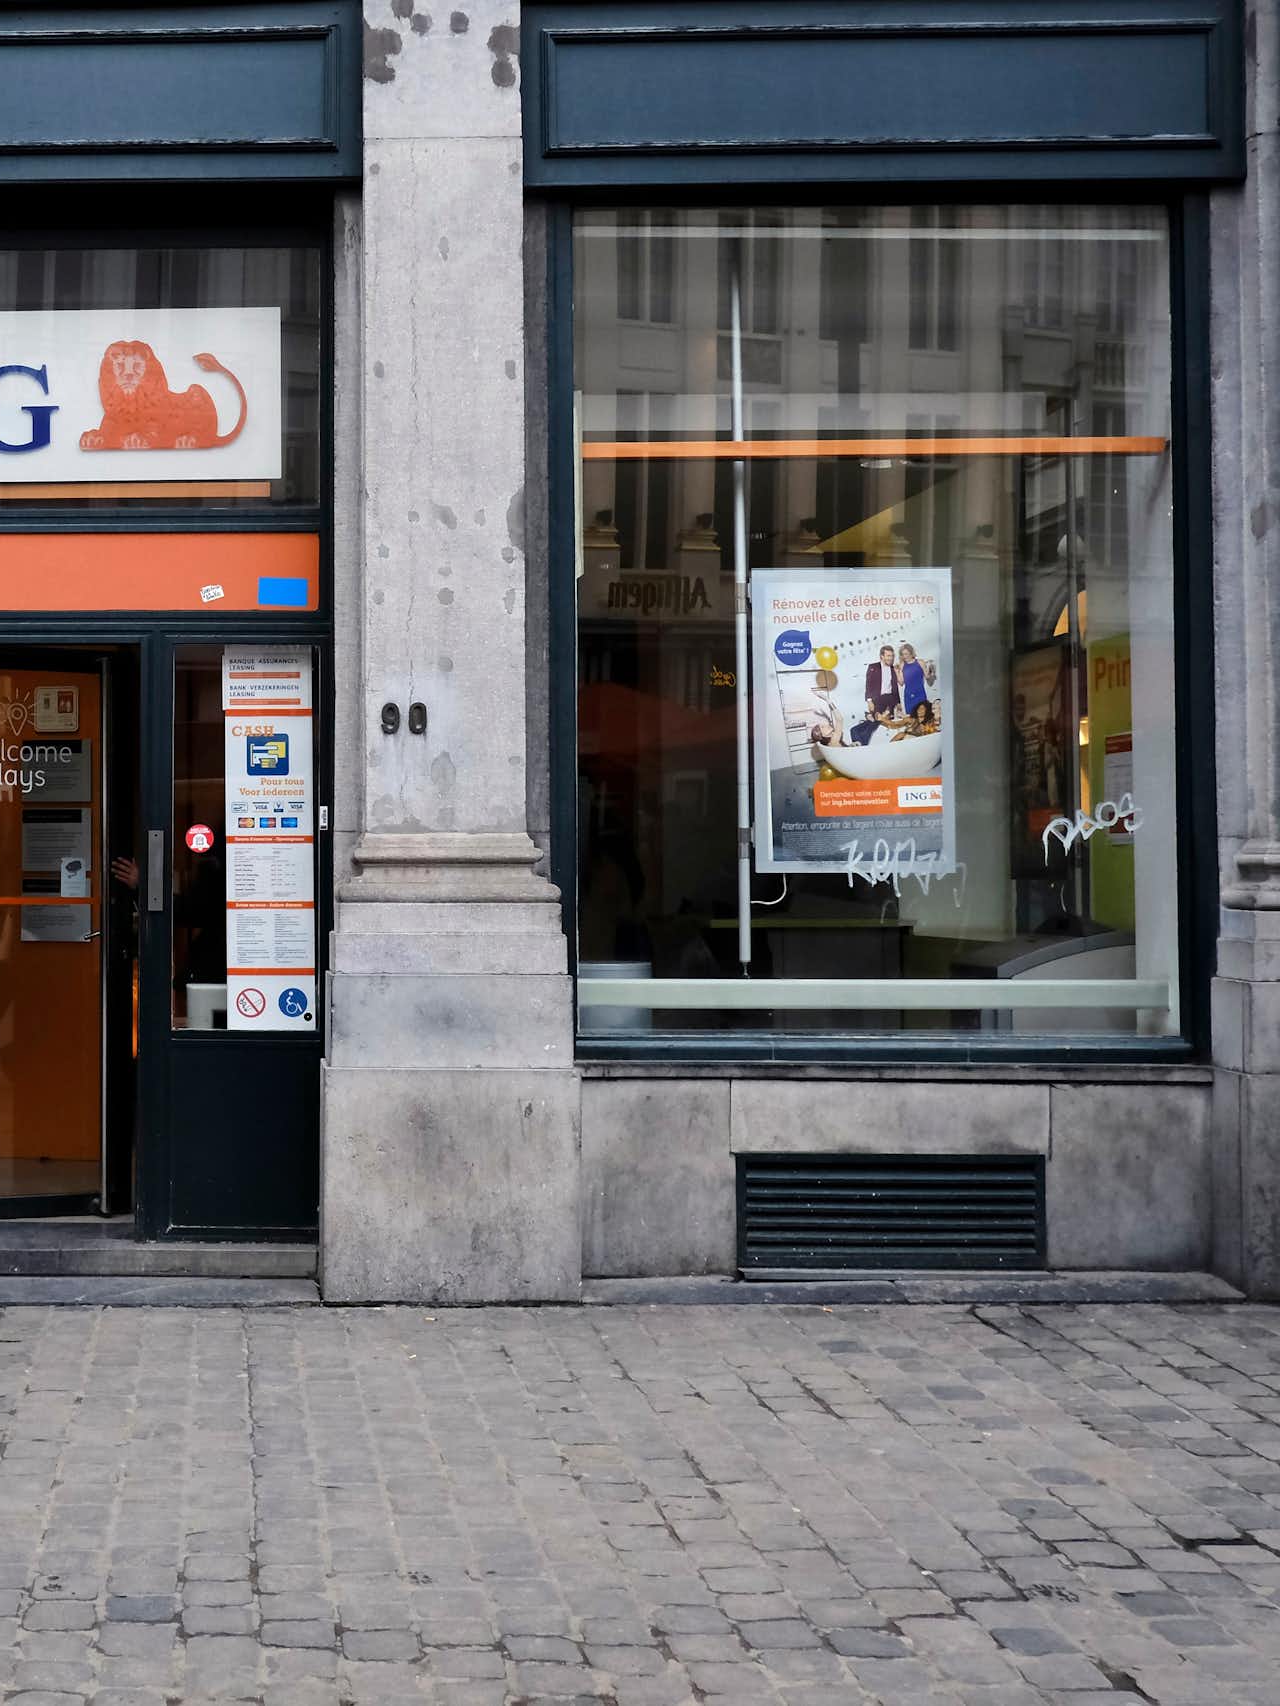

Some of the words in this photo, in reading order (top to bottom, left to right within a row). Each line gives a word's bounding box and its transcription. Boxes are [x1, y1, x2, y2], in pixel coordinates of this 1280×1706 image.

[772, 598, 824, 610] Rénovez
[828, 598, 841, 608] et
[845, 595, 897, 607] célébrez
[900, 594, 934, 605] votre
[773, 611, 827, 624] nouvelle
[831, 610, 860, 622] salle
[863, 609, 880, 621] de
[883, 608, 911, 620] bain
[231, 725, 275, 737] CASH
[260, 777, 282, 786] Pour
[284, 777, 304, 786] tous
[239, 787, 260, 796] Voor
[263, 787, 304, 796] iedereen
[905, 791, 928, 801] ING
